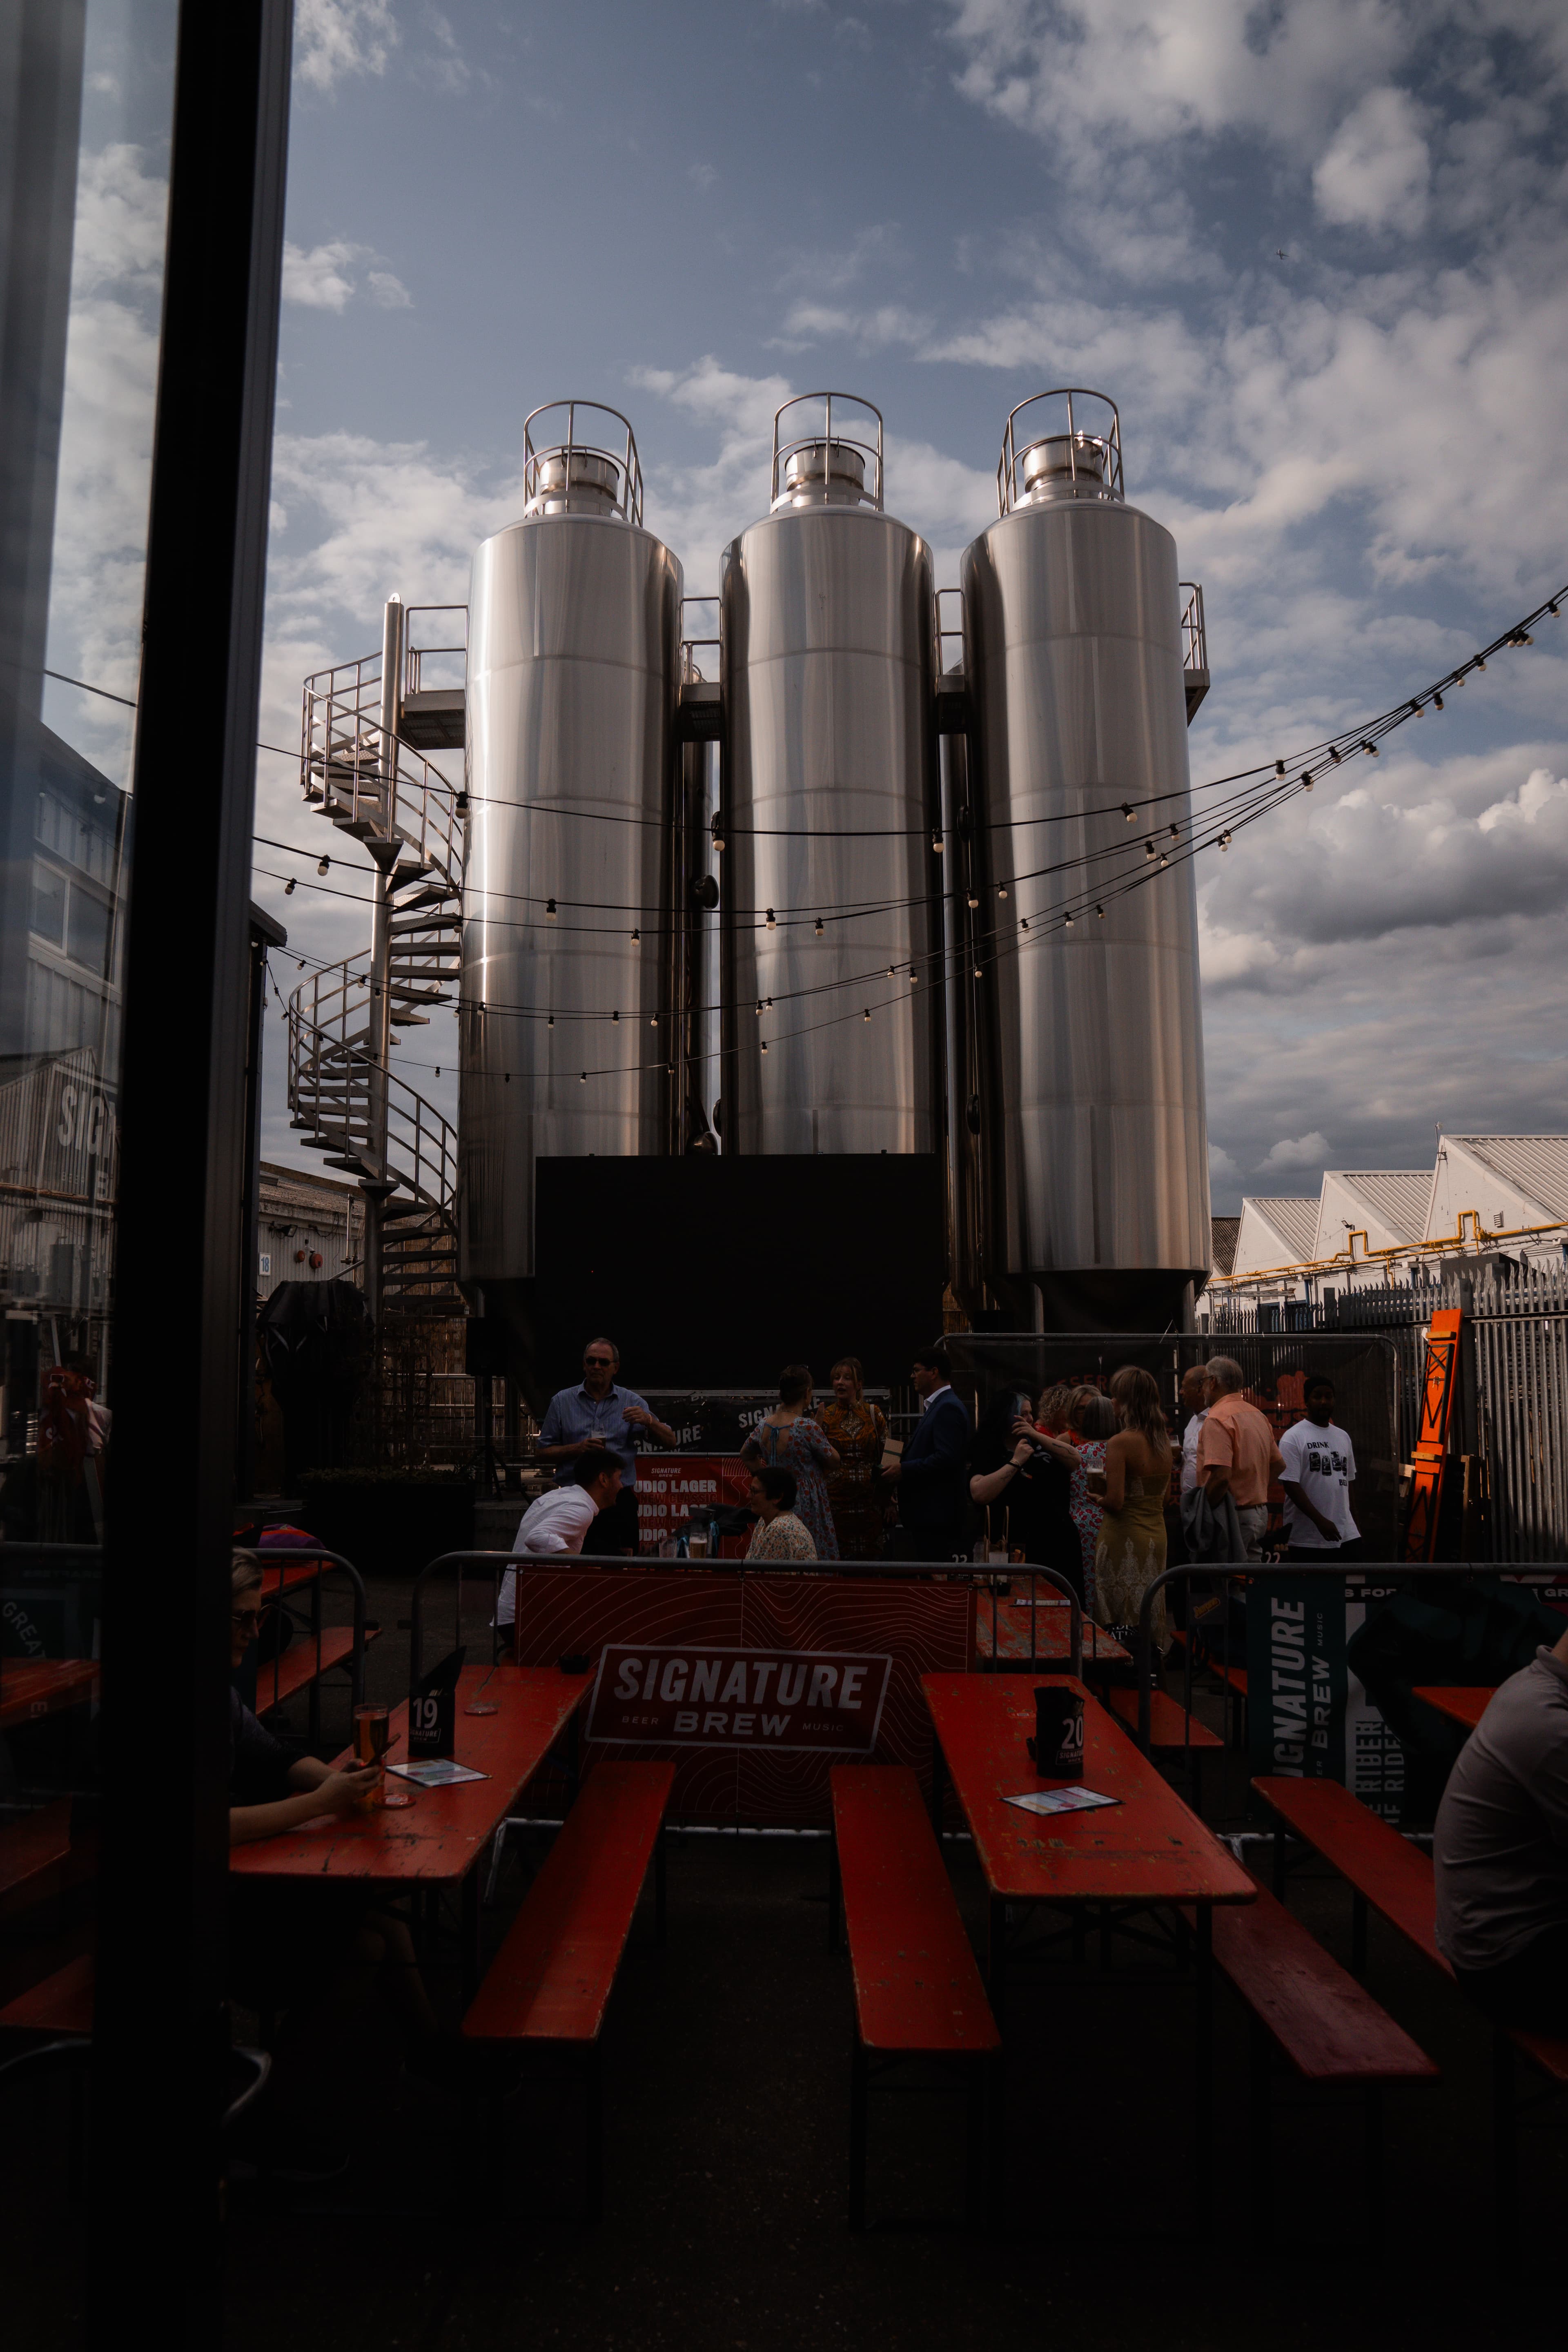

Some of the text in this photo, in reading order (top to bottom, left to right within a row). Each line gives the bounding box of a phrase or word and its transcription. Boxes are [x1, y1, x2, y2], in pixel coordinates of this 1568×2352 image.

[261, 1256, 270, 1272] 18
[633, 1480, 717, 1493] UDIO LAGER
[668, 1493, 718, 1504] CLASSIC
[614, 1657, 869, 1709] SIGNATURE
[1271, 1597, 1307, 1777] IGNATURE
[412, 1697, 438, 1728] 19
[1311, 1655, 1332, 1750] BREW
[621, 1711, 844, 1737] BEER BREW MUSIC
[1061, 1715, 1083, 1749] 20
